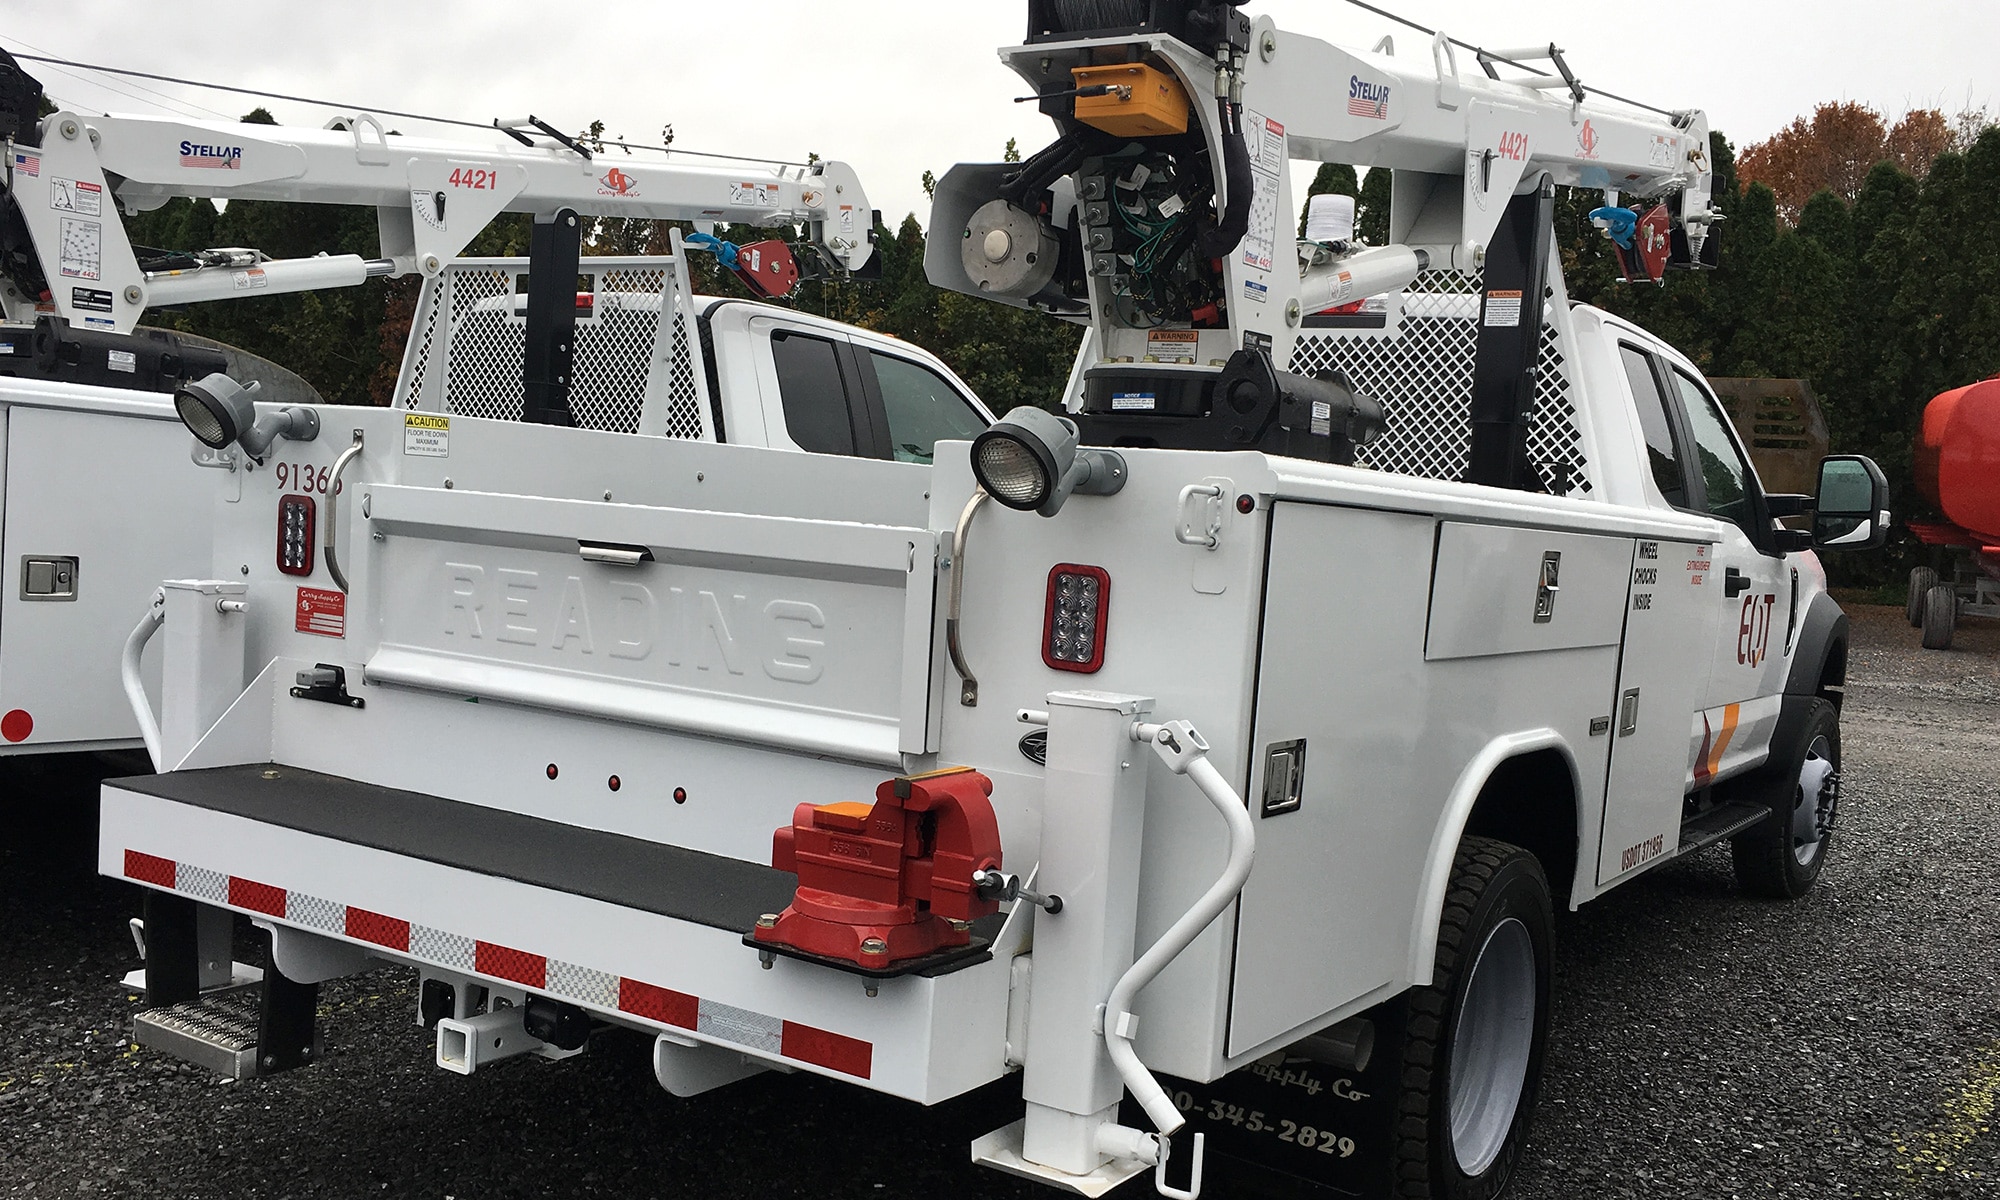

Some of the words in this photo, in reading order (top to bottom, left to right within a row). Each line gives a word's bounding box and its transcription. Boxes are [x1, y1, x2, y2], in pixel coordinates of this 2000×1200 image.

[1349, 75, 1390, 103] STELLAR
[179, 140, 241, 158] STELLAR
[1498, 131, 1528, 161] 4421
[448, 168, 497, 190] 4421
[1160, 332, 1194, 341] WARNING
[414, 416, 449, 428] CAUTION
[407, 429, 424, 437] FLOOR
[416, 438, 438, 446] MAXIMUM
[1639, 541, 1658, 560] WHEEL
[1633, 567, 1658, 585] CHOCKS
[1632, 593, 1652, 611] INSIDE
[444, 562, 826, 685] READING
[1737, 594, 1775, 669] EQT
[1621, 842, 1642, 872] USDOT
[1332, 1078, 1371, 1101] Co
